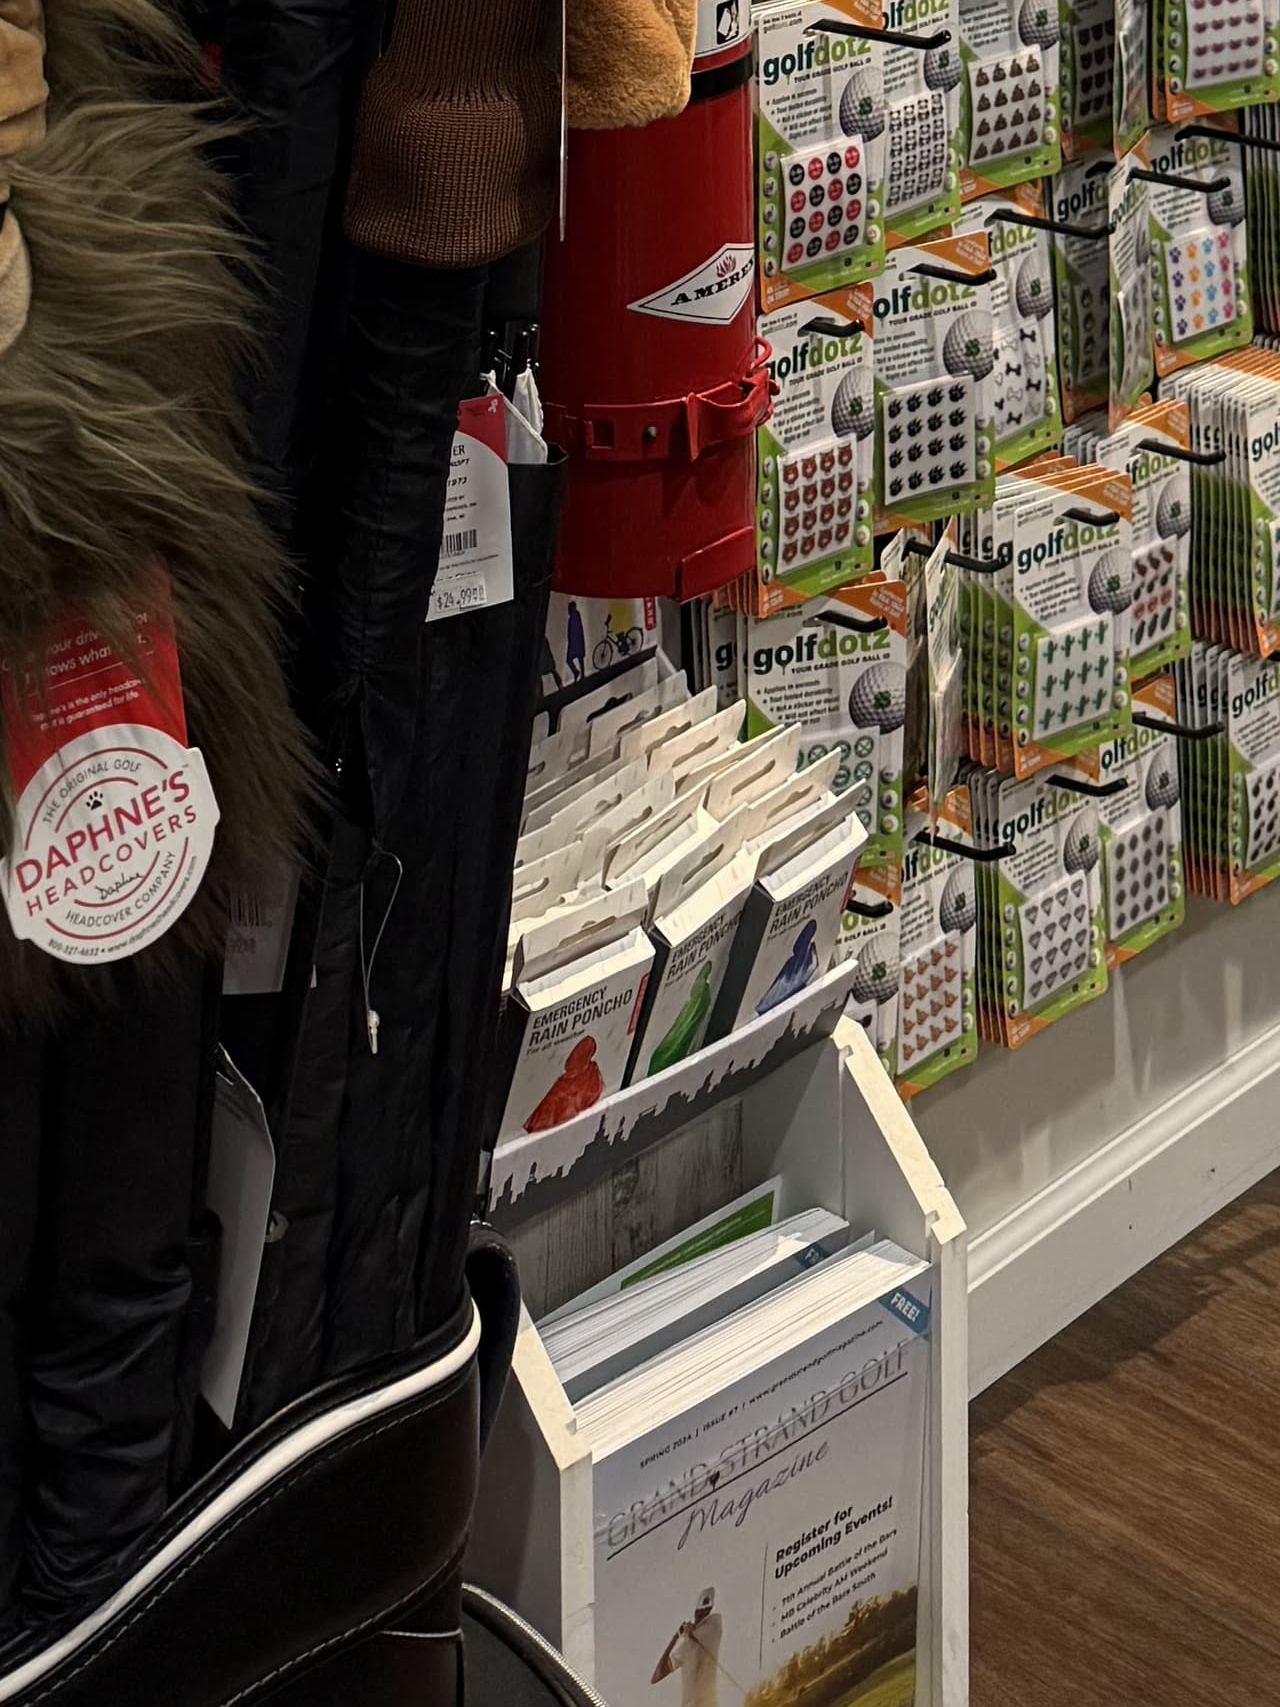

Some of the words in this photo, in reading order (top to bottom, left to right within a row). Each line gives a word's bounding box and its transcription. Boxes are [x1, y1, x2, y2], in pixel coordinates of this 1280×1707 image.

[763, 37, 871, 86] golfdotz
[1017, 524, 1120, 574] golfdotz
[79, 645, 111, 666] what
[753, 629, 891, 675] golfdotz
[862, 654, 880, 662] BALL
[42, 799, 62, 825] THE
[59, 761, 111, 799] ORIGINAL
[113, 759, 141, 774] GOLF
[1002, 790, 1087, 842] golfdotz
[15, 769, 190, 895] DAPHNE'S
[25, 804, 197, 917] HEADCOVERS
[66, 903, 132, 928] HEADCOVER
[135, 850, 177, 911] COMPANY
[771, 903, 801, 932] RAIN
[803, 872, 848, 914] PONCHO
[775, 873, 831, 917] EMERGENCY
[667, 951, 696, 980] RAIN
[699, 911, 743, 957] PONCHO
[672, 912, 726, 962] EMERGENCY
[529, 1019, 568, 1047] RAIN
[572, 989, 633, 1029] PONCHO
[533, 986, 607, 1029] EMERGENCY
[890, 1291, 920, 1322] FREE!
[640, 1444, 670, 1468] SPRING
[673, 1434, 692, 1450] 2024
[703, 1413, 726, 1431] ISSUE
[607, 1463, 715, 1547] GRAND
[720, 1390, 827, 1477] STRAND
[677, 1440, 831, 1550] Magazine
[775, 1530, 842, 1579] Upcoming
[845, 1495, 893, 1535] Events!
[776, 1519, 831, 1563] Register
[834, 1505, 853, 1525] for
[797, 1573, 826, 1595] Annual
[827, 1556, 852, 1576] Battle
[854, 1547, 862, 1559] of
[864, 1541, 877, 1553] the
[835, 1573, 848, 1588] AM
[780, 1617, 805, 1638] Battle
[807, 1609, 815, 1621] of
[817, 1602, 830, 1614] the
